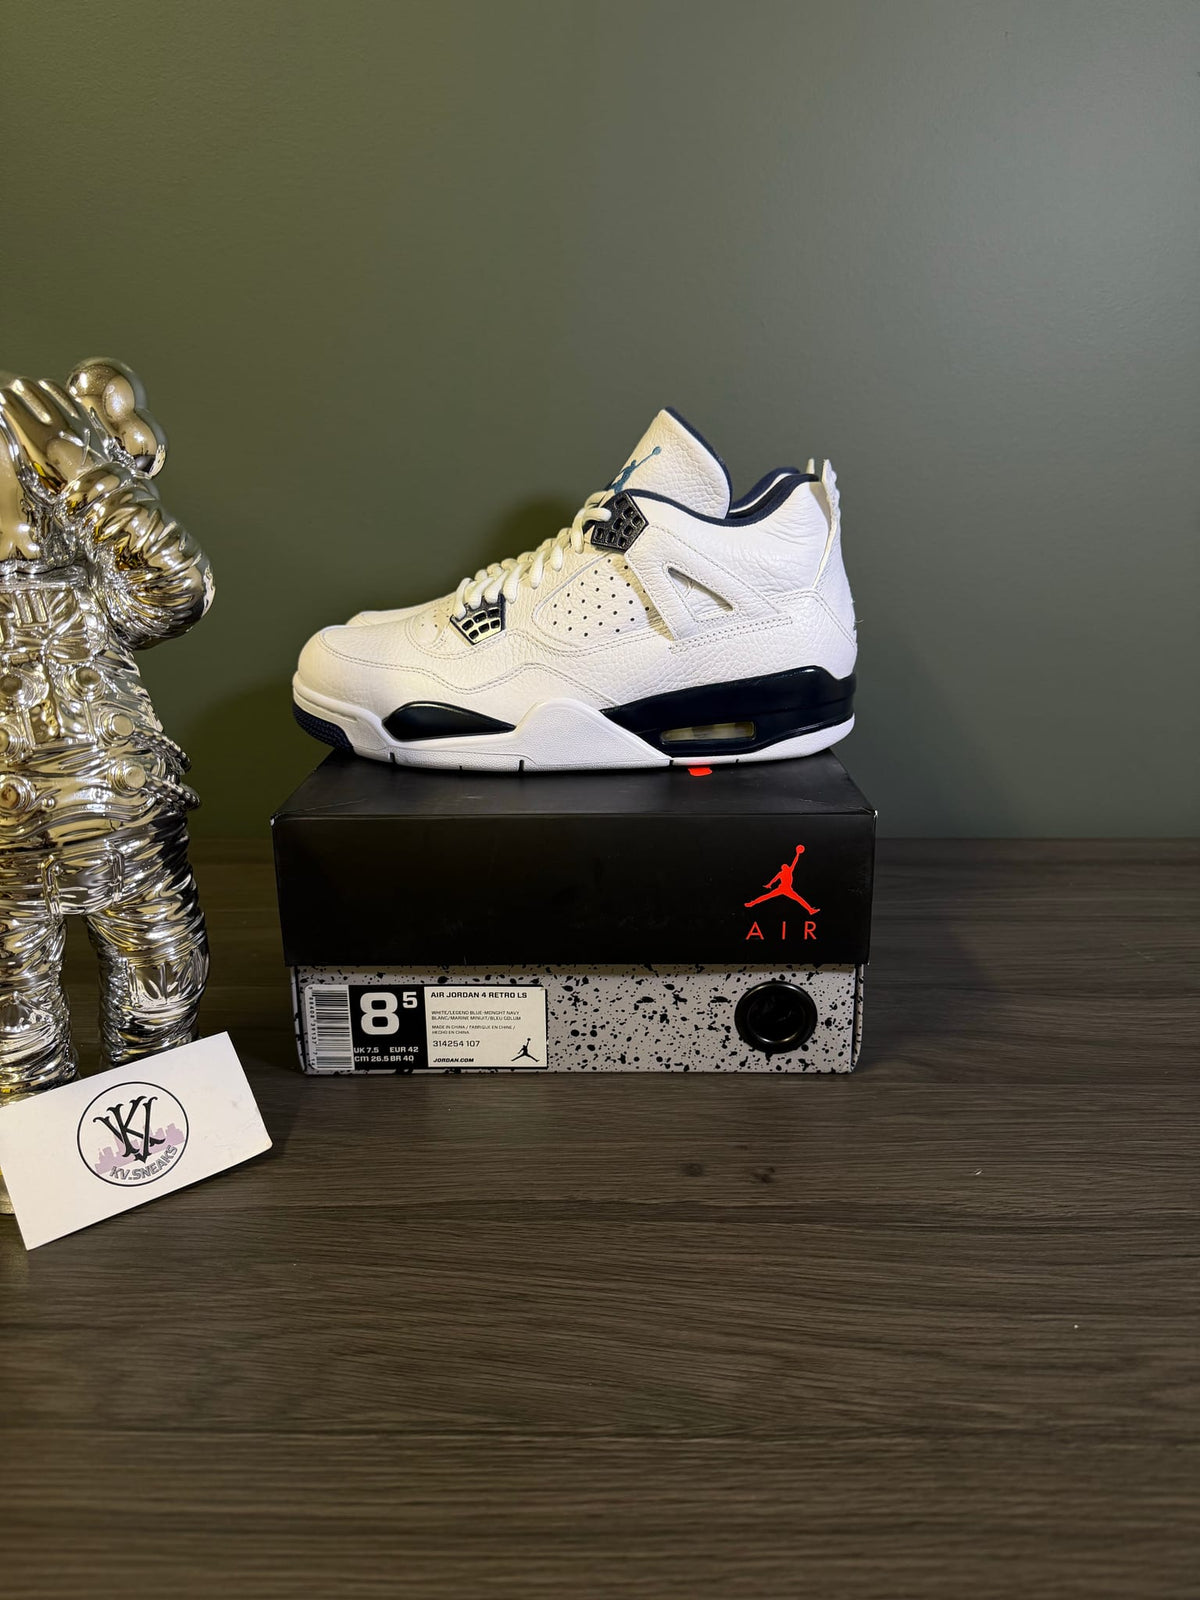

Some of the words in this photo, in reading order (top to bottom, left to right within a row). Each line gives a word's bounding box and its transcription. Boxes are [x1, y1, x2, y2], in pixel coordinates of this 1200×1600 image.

[745, 921, 817, 940] AIR
[360, 992, 399, 1035] 8
[402, 991, 418, 1009] 5
[432, 1040, 464, 1048] 314254
[466, 1040, 480, 1048] 107
[109, 1144, 178, 1181] KV.SNEAKS
